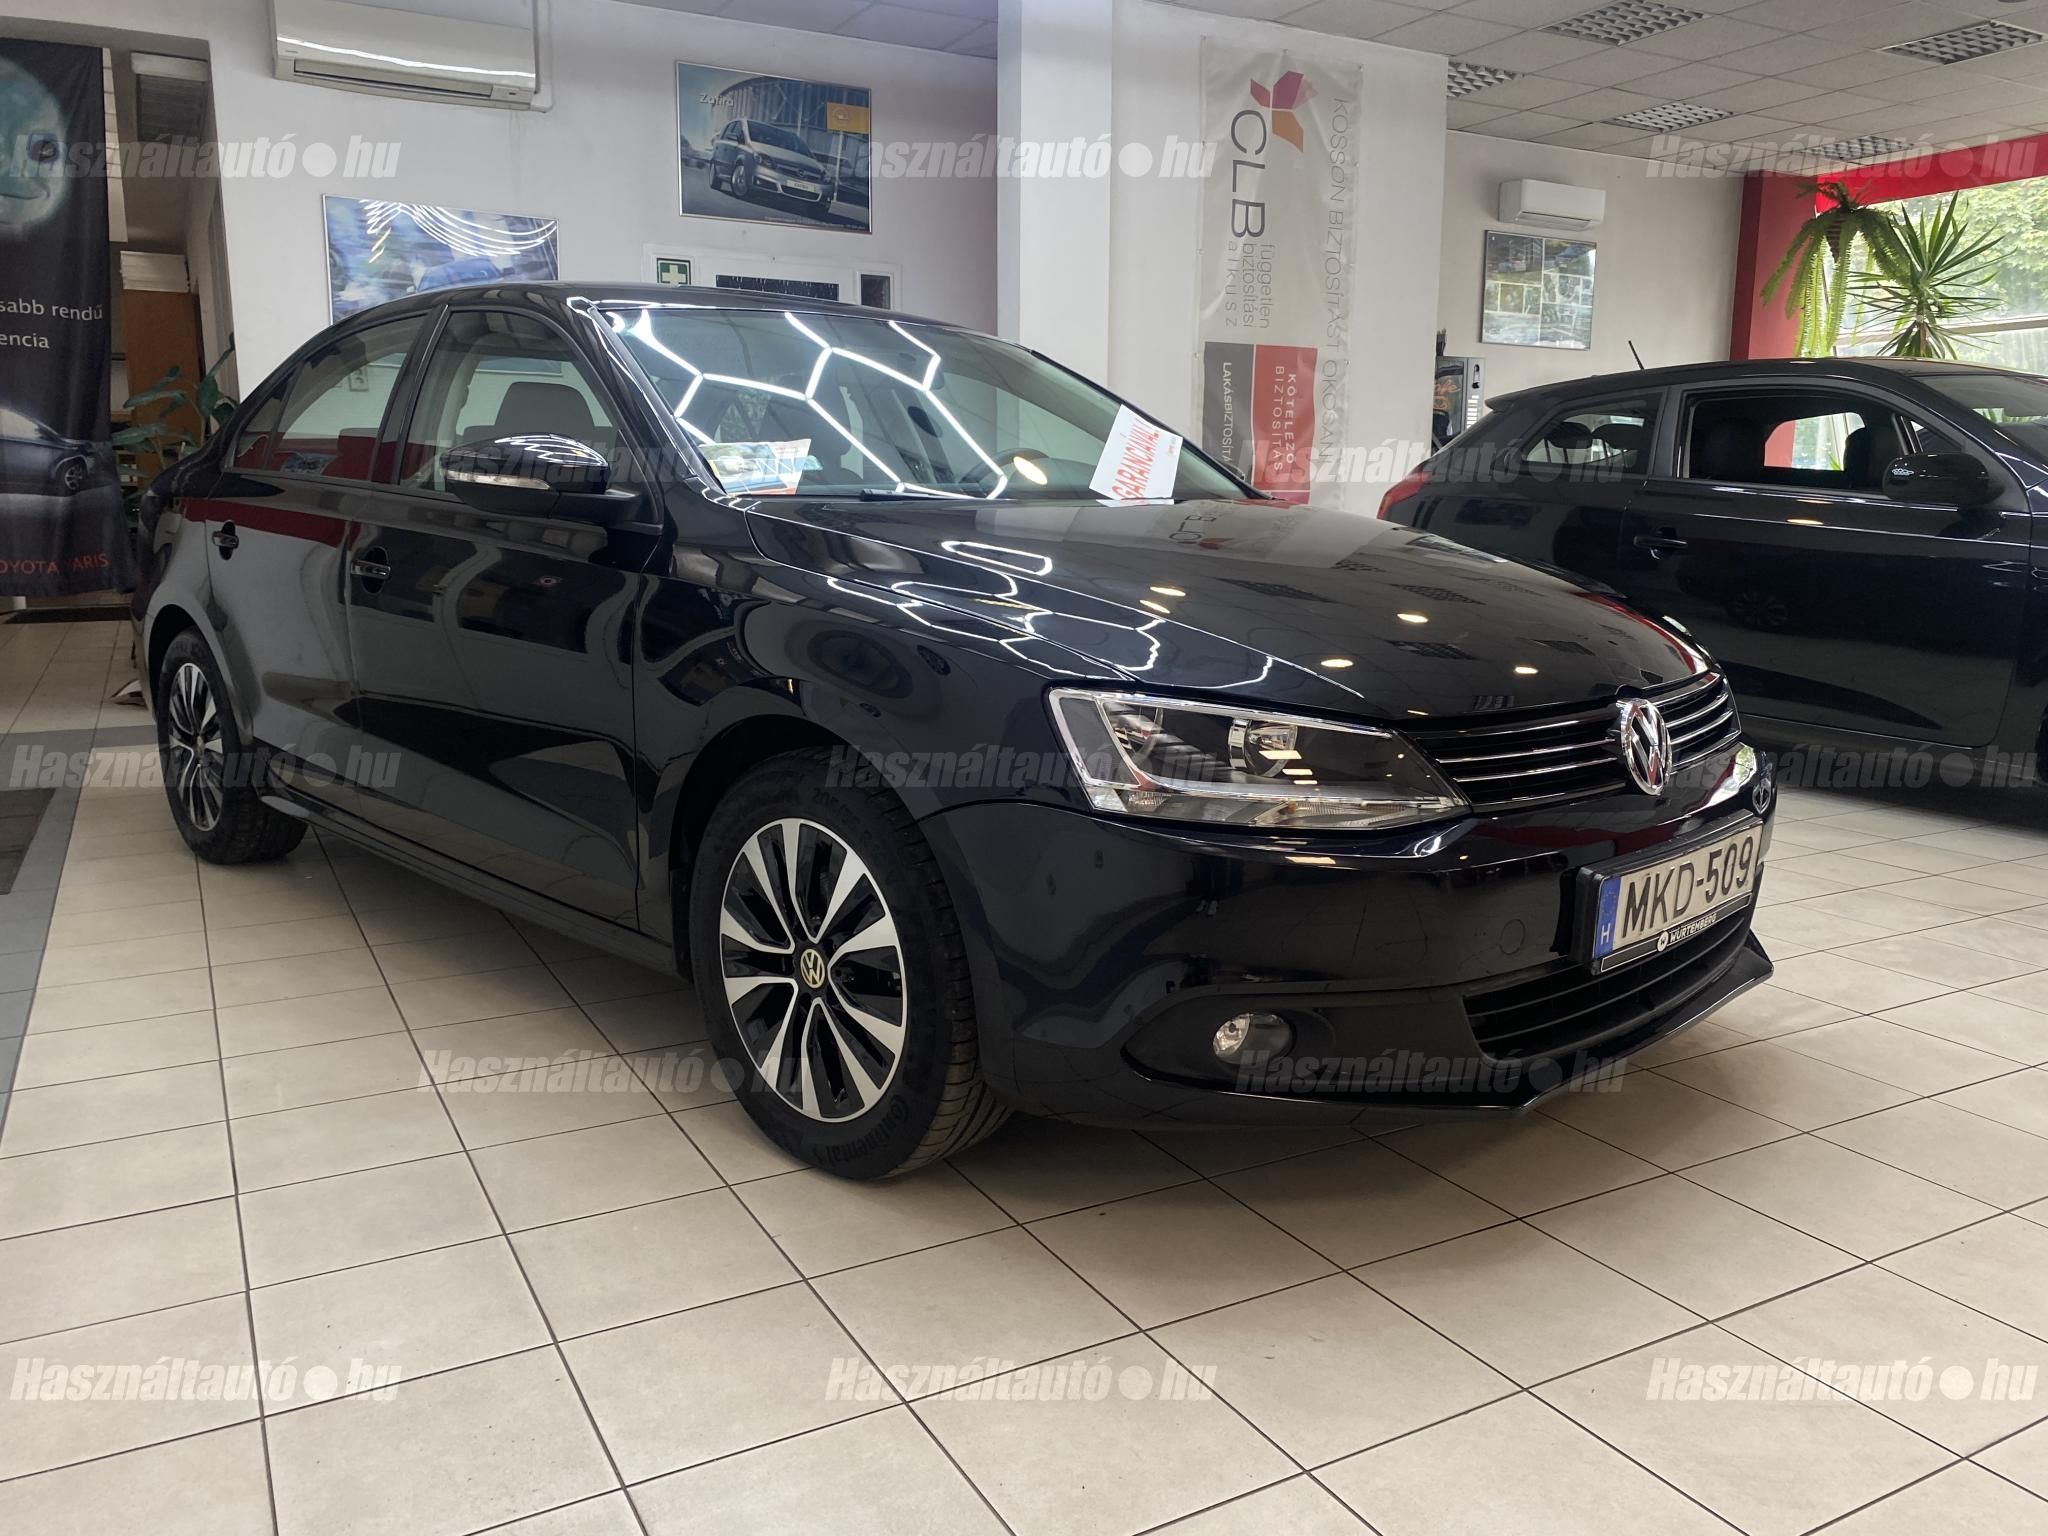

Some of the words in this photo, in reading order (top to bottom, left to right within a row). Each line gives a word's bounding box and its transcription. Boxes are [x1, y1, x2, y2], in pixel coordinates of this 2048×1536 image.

[1231, 109, 1267, 238] CLB
[1329, 98, 1349, 202] KOSSON
[1225, 241, 1240, 328] alkusz
[0, 333, 50, 349] encia
[1271, 366, 1285, 471] BIZTOSÍTÁS
[1601, 923, 1611, 945] H
[1622, 836, 1754, 938] MKD-509
